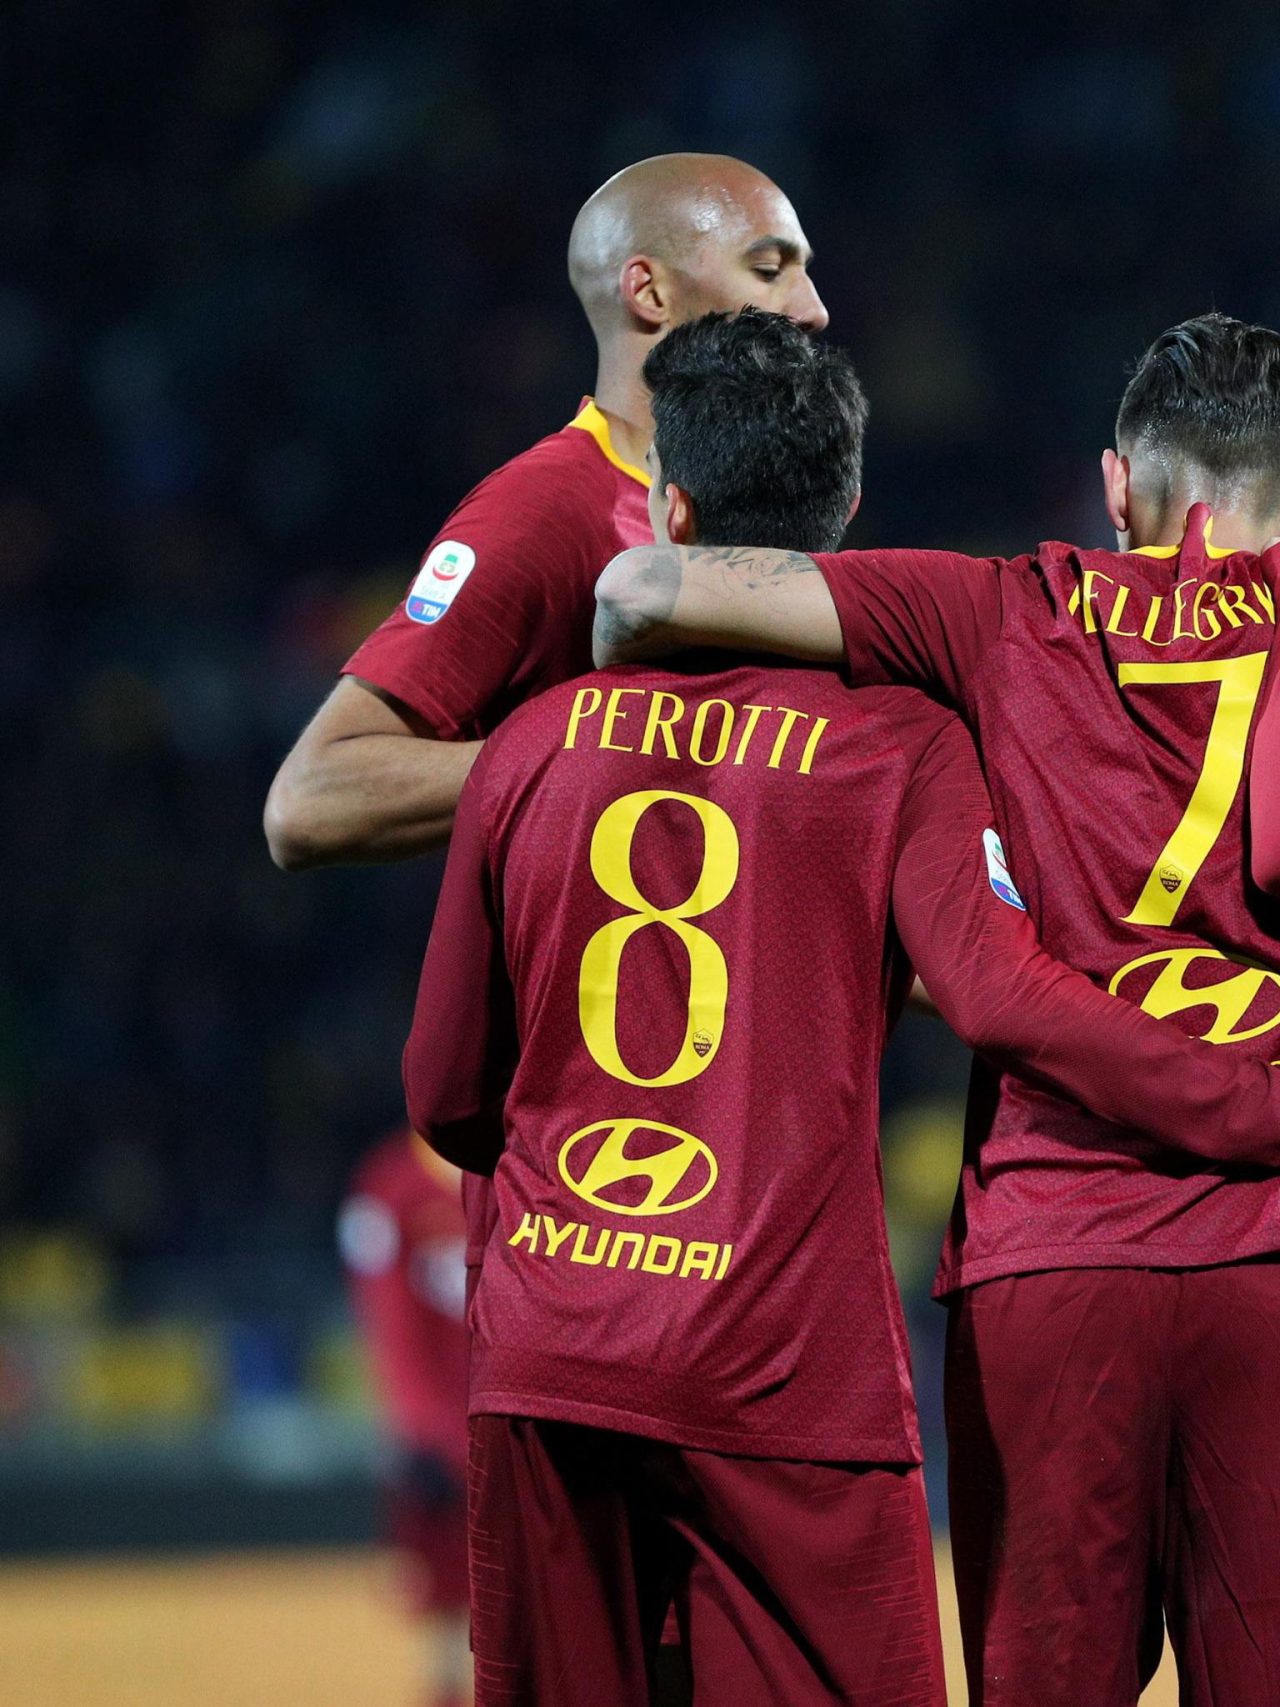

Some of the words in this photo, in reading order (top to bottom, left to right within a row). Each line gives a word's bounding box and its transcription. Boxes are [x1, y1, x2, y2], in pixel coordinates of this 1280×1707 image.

[563, 687, 830, 775] PEROTTI
[1117, 650, 1269, 927] 7
[578, 789, 740, 1088] 8
[507, 1212, 733, 1281] HYUNDAI
